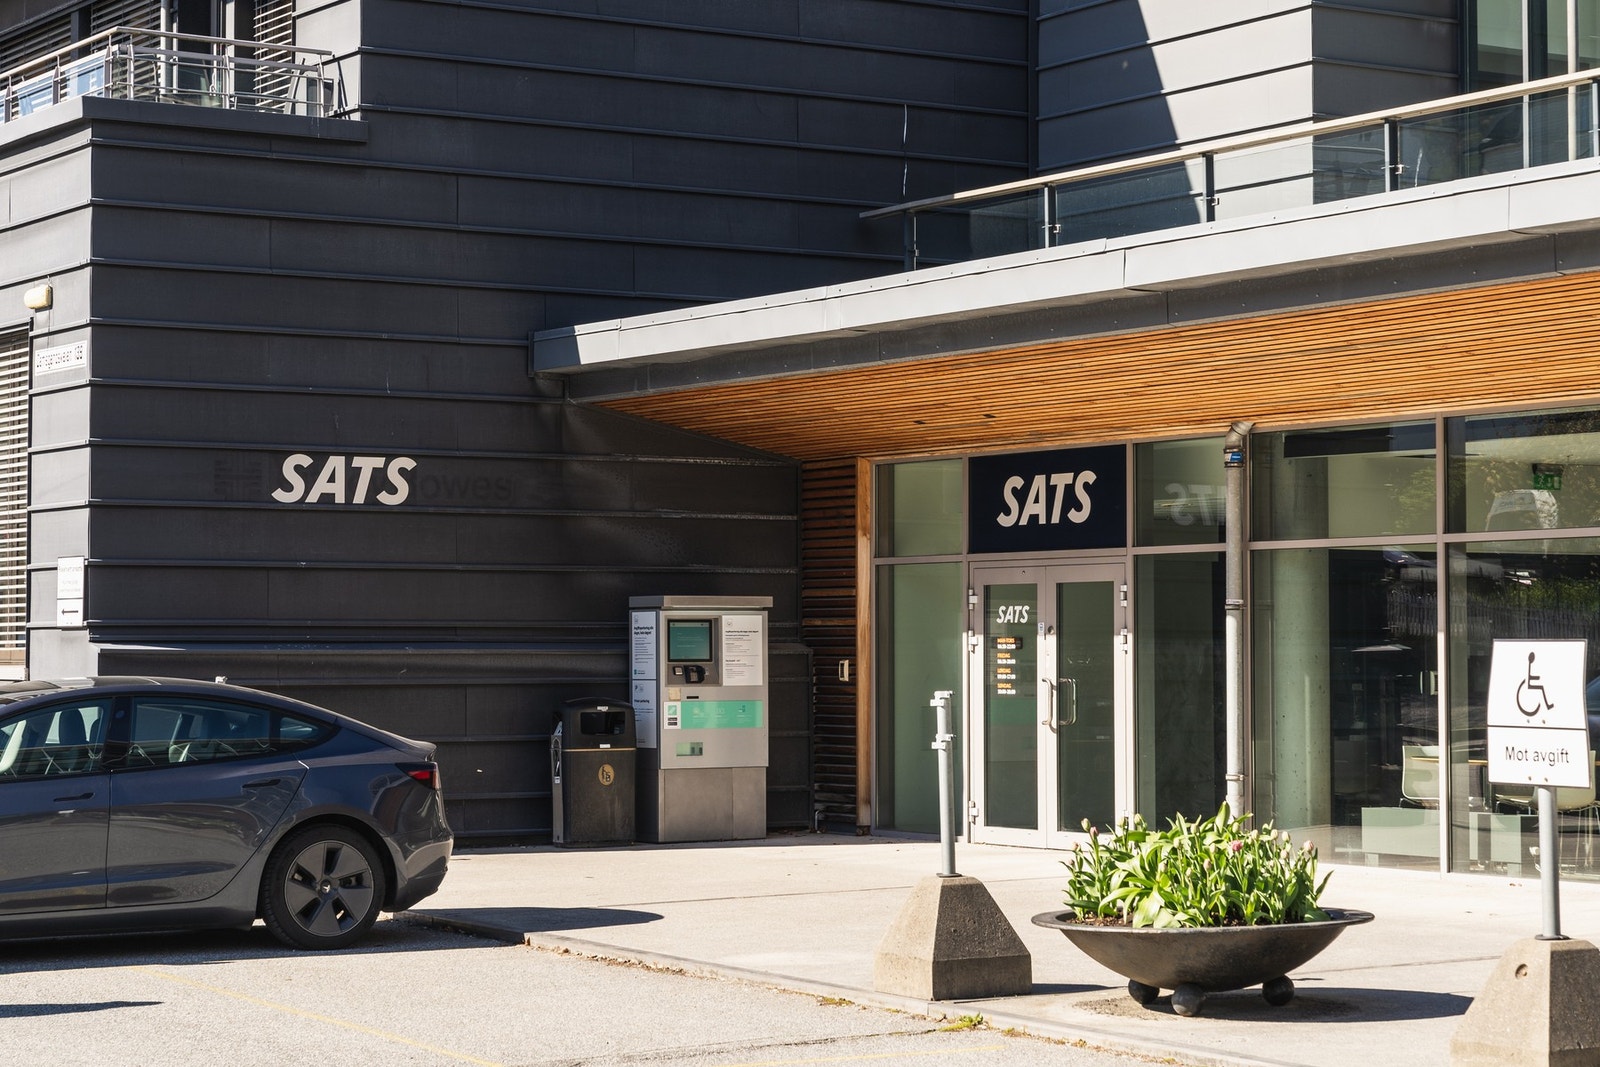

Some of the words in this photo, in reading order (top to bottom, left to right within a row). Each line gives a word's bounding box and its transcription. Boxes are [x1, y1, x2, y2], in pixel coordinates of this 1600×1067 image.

[271, 454, 418, 506] SATS
[996, 470, 1097, 528] SATS
[996, 605, 1030, 624] SATS
[1505, 746, 1529, 762] Mot
[1532, 748, 1570, 767] avgift
